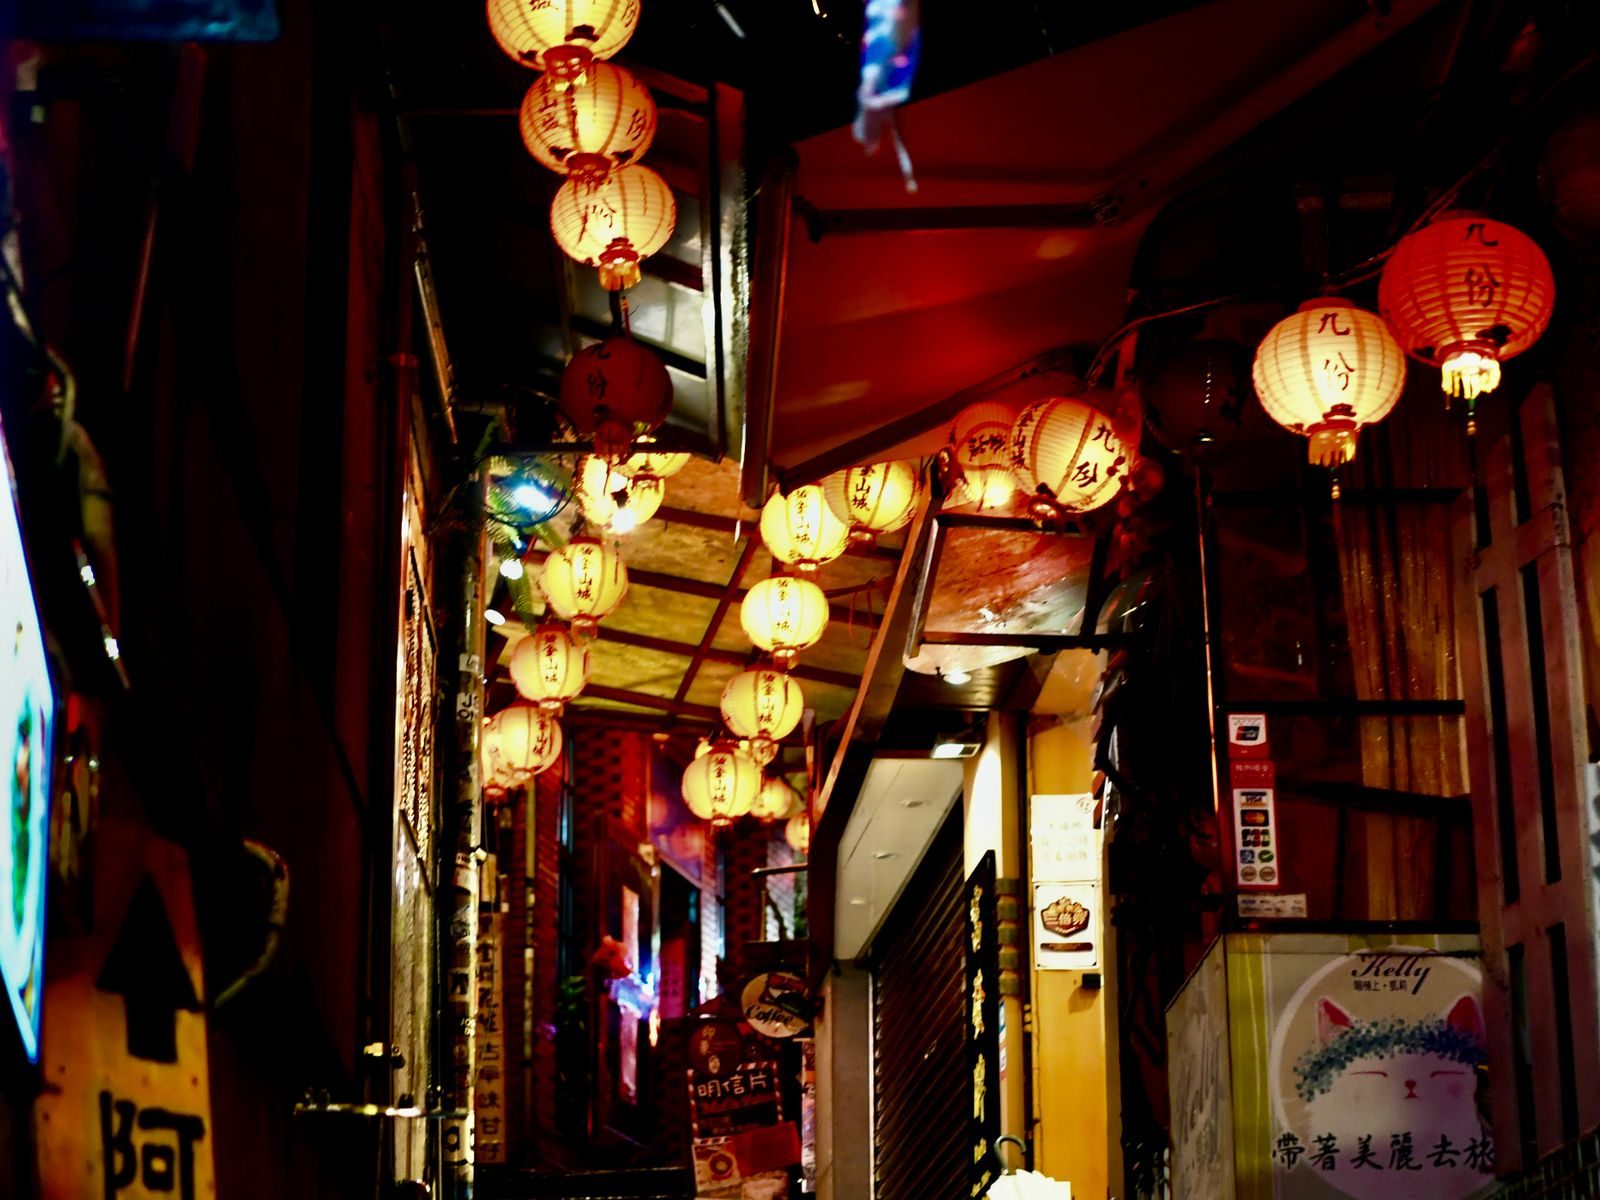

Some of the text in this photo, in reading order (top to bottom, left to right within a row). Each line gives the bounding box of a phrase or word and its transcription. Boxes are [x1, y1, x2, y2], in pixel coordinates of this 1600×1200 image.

[1465, 223, 1499, 307] 九份
[1317, 312, 1356, 391] 九份
[1070, 422, 1116, 489] 九份
[1351, 950, 1432, 995] Kelly
[697, 1072, 768, 1098] 明信片
[100, 1090, 206, 1200] 阿
[1272, 1132, 1497, 1174] 帶著美麗去旅
